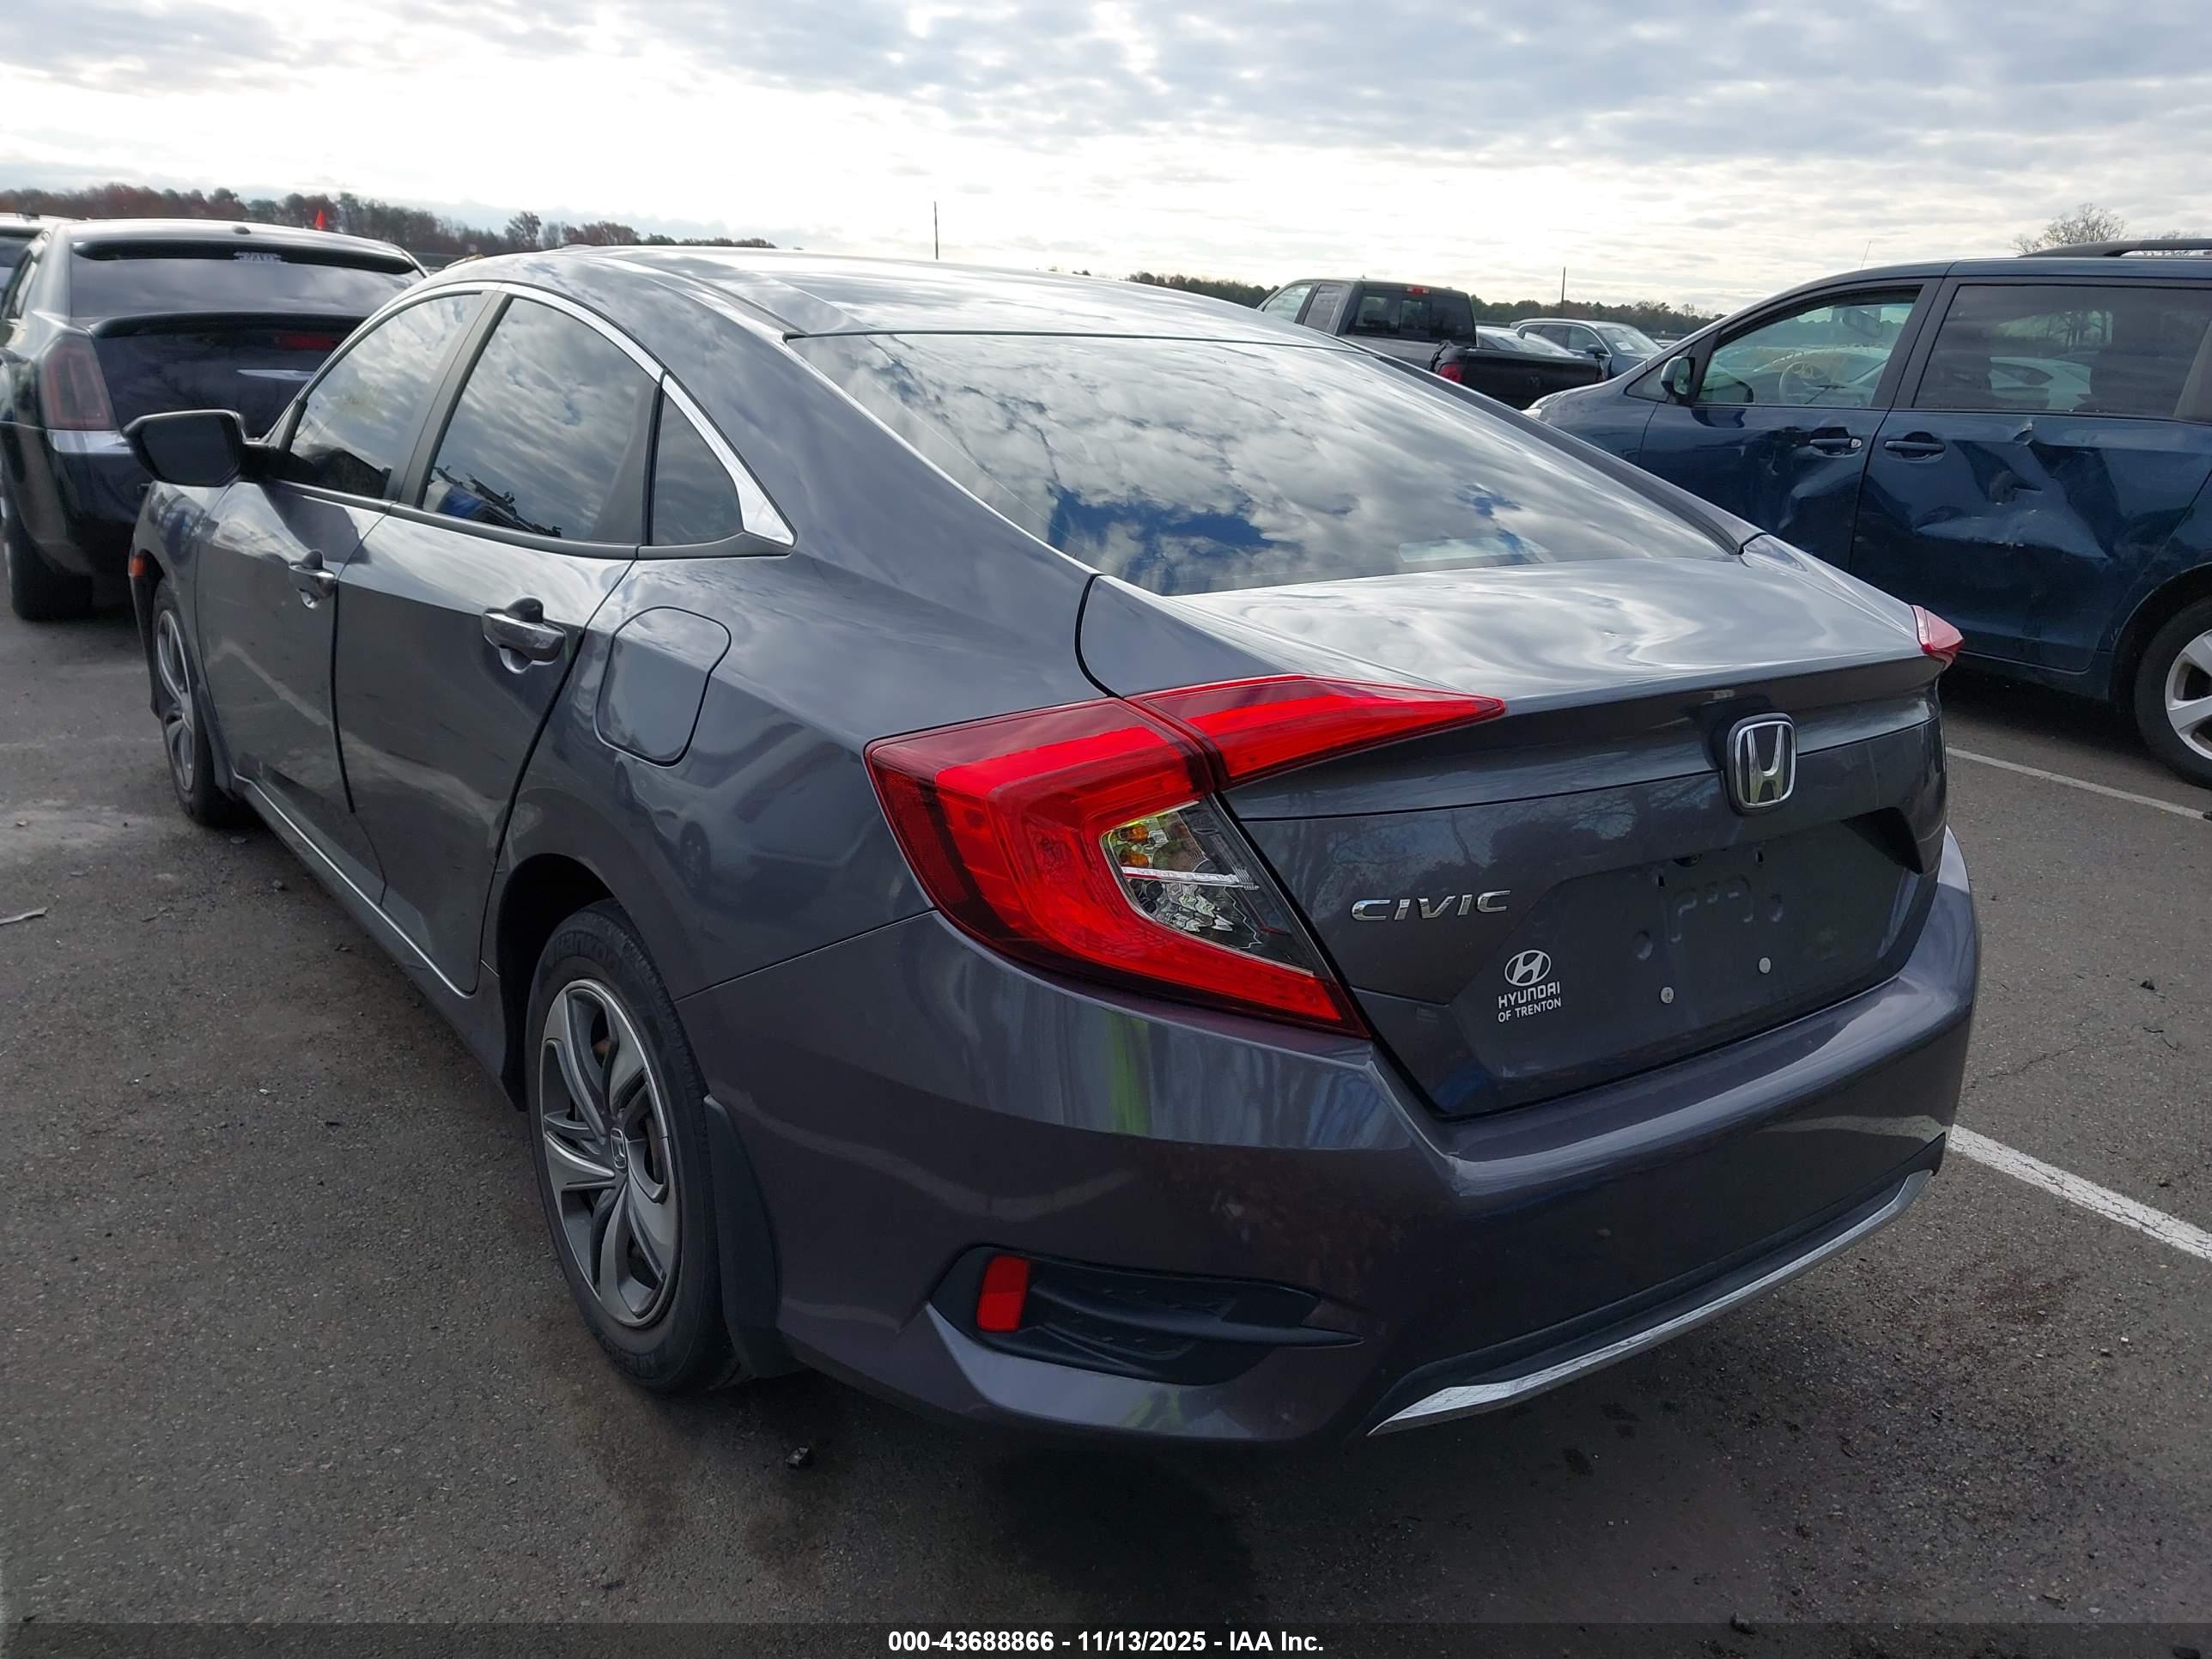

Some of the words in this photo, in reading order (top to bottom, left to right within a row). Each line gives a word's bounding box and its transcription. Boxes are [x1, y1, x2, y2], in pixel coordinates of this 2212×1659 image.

[1352, 890, 1510, 921] CIVIC
[1498, 981, 1560, 1009] HYUNDAI
[1498, 1010, 1511, 1023] OF
[1515, 997, 1561, 1018] TRENTON
